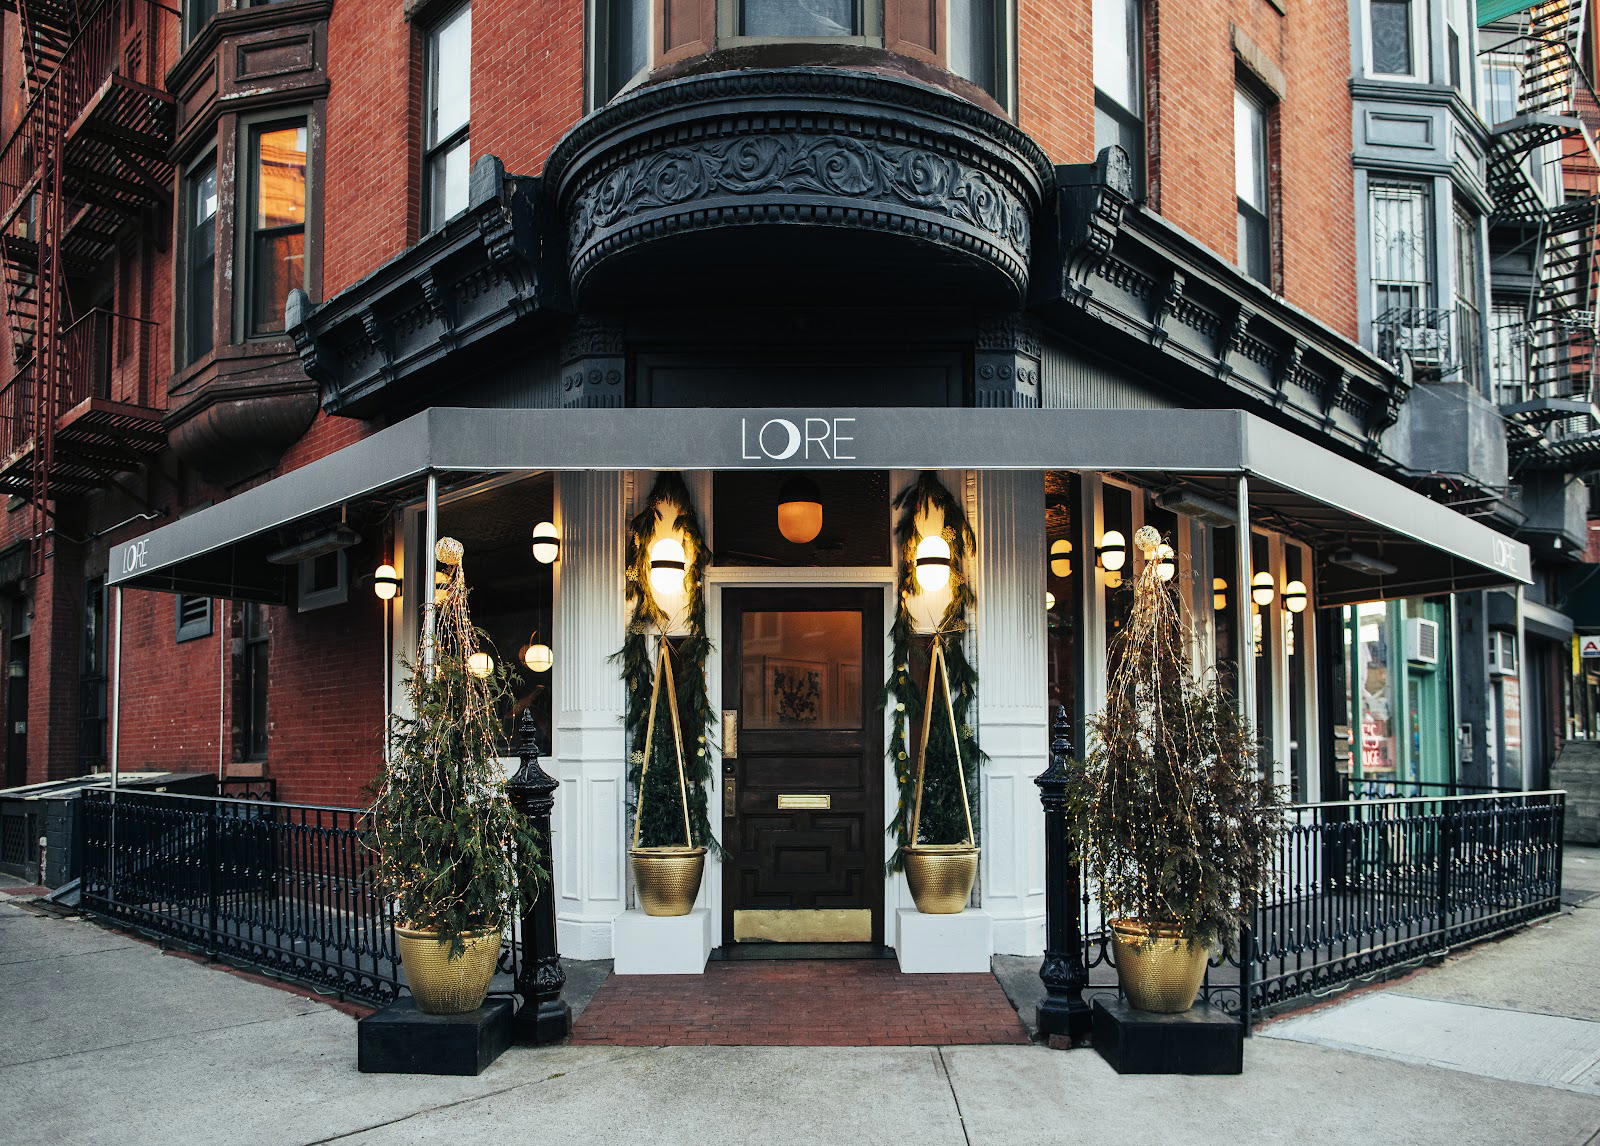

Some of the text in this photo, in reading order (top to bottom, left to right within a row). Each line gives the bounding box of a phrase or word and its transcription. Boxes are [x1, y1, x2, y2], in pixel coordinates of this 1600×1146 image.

[742, 418, 856, 460] LORE
[122, 538, 150, 574] LORE
[1491, 535, 1517, 573] LORE
